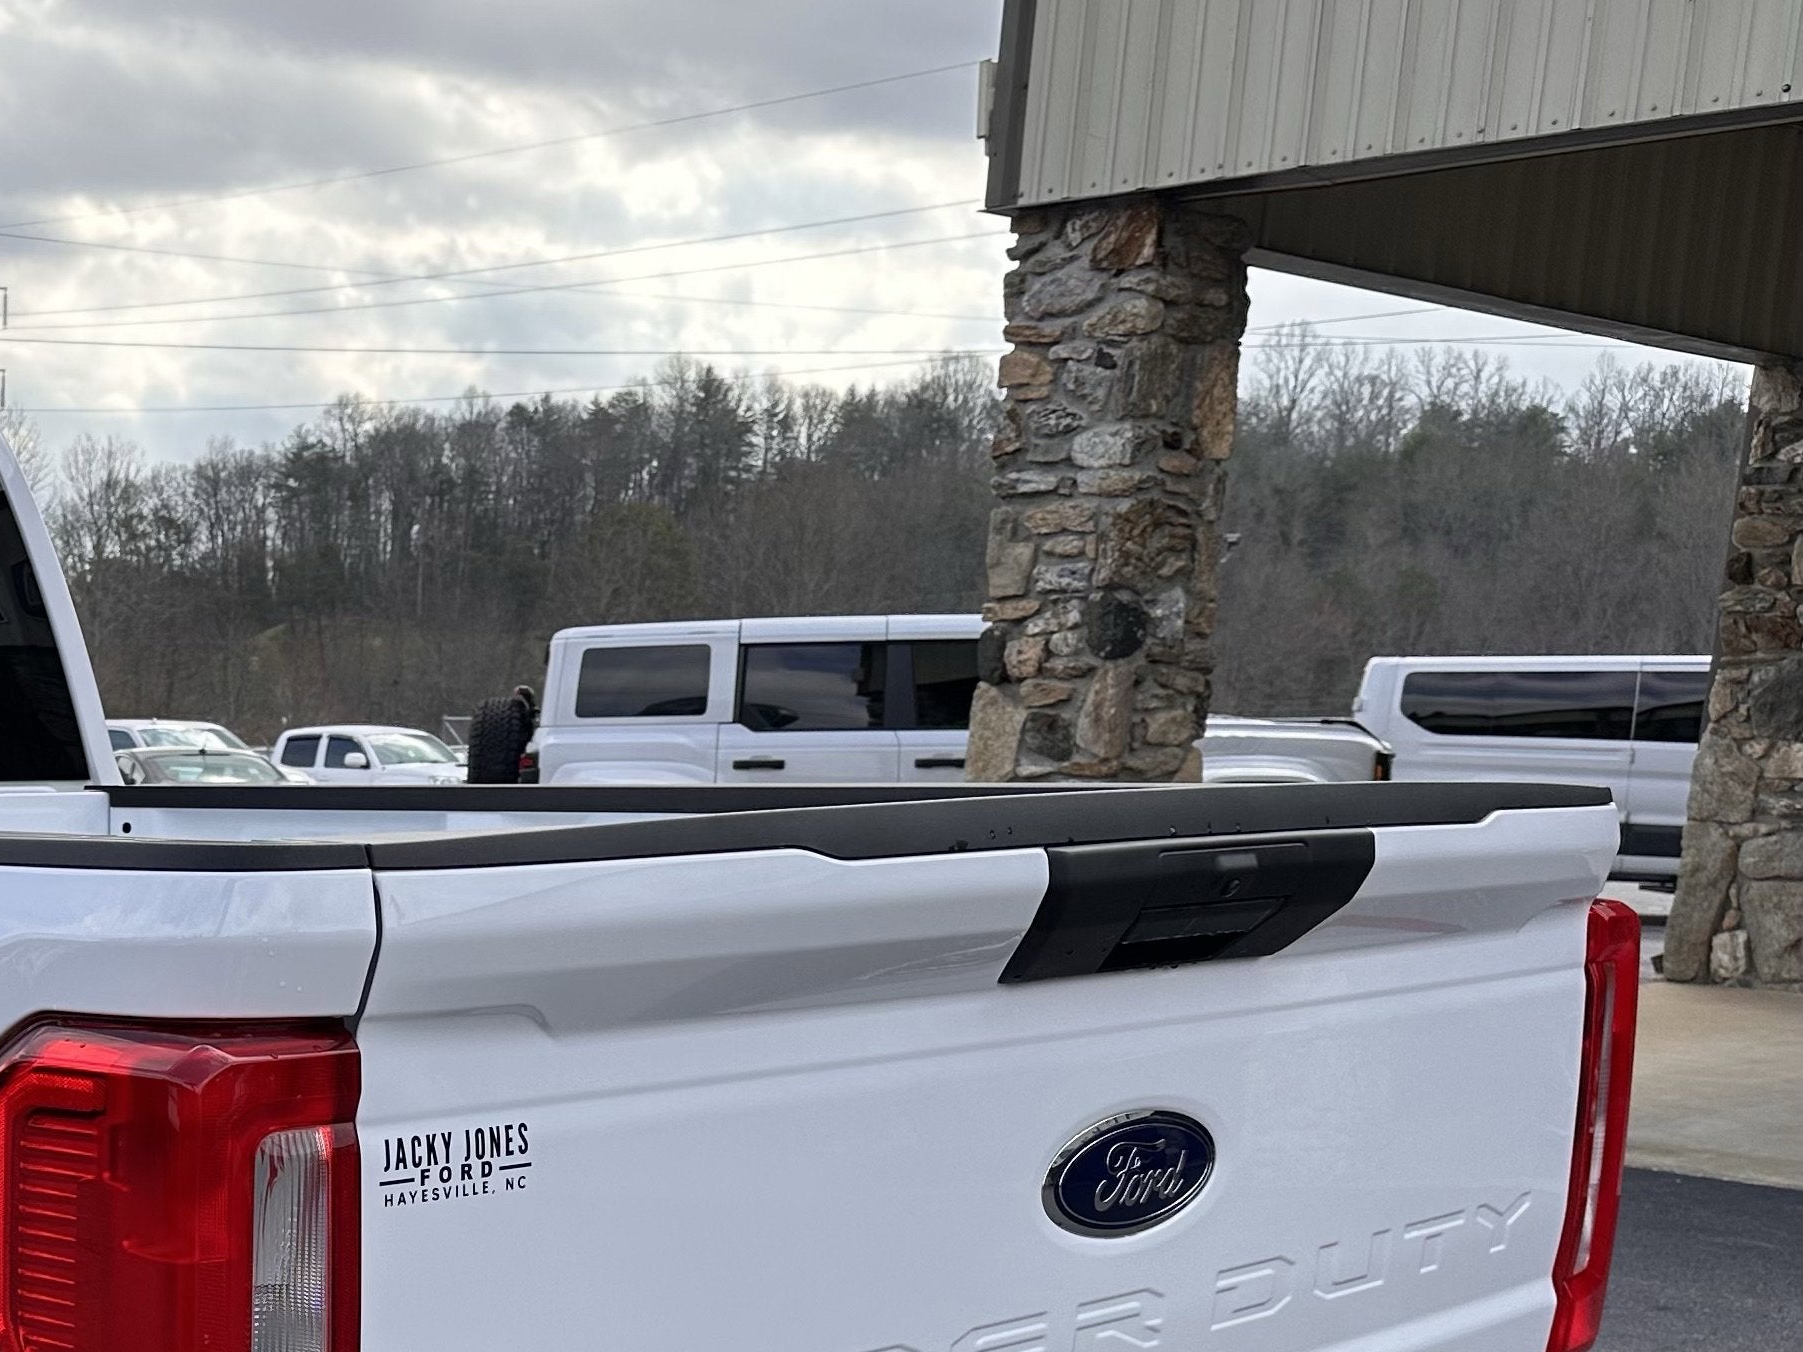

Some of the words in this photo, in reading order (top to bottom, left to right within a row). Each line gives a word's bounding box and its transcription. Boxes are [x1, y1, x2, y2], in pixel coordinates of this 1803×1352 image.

[383, 1131, 452, 1173] JACKY
[464, 1122, 529, 1162] JONES
[384, 1181, 496, 1208] HAYESVILLE,
[505, 1175, 527, 1191] NC
[420, 1161, 493, 1187] FORD
[1094, 1138, 1186, 1212] Ford
[1208, 1191, 1532, 1332] DUTY
